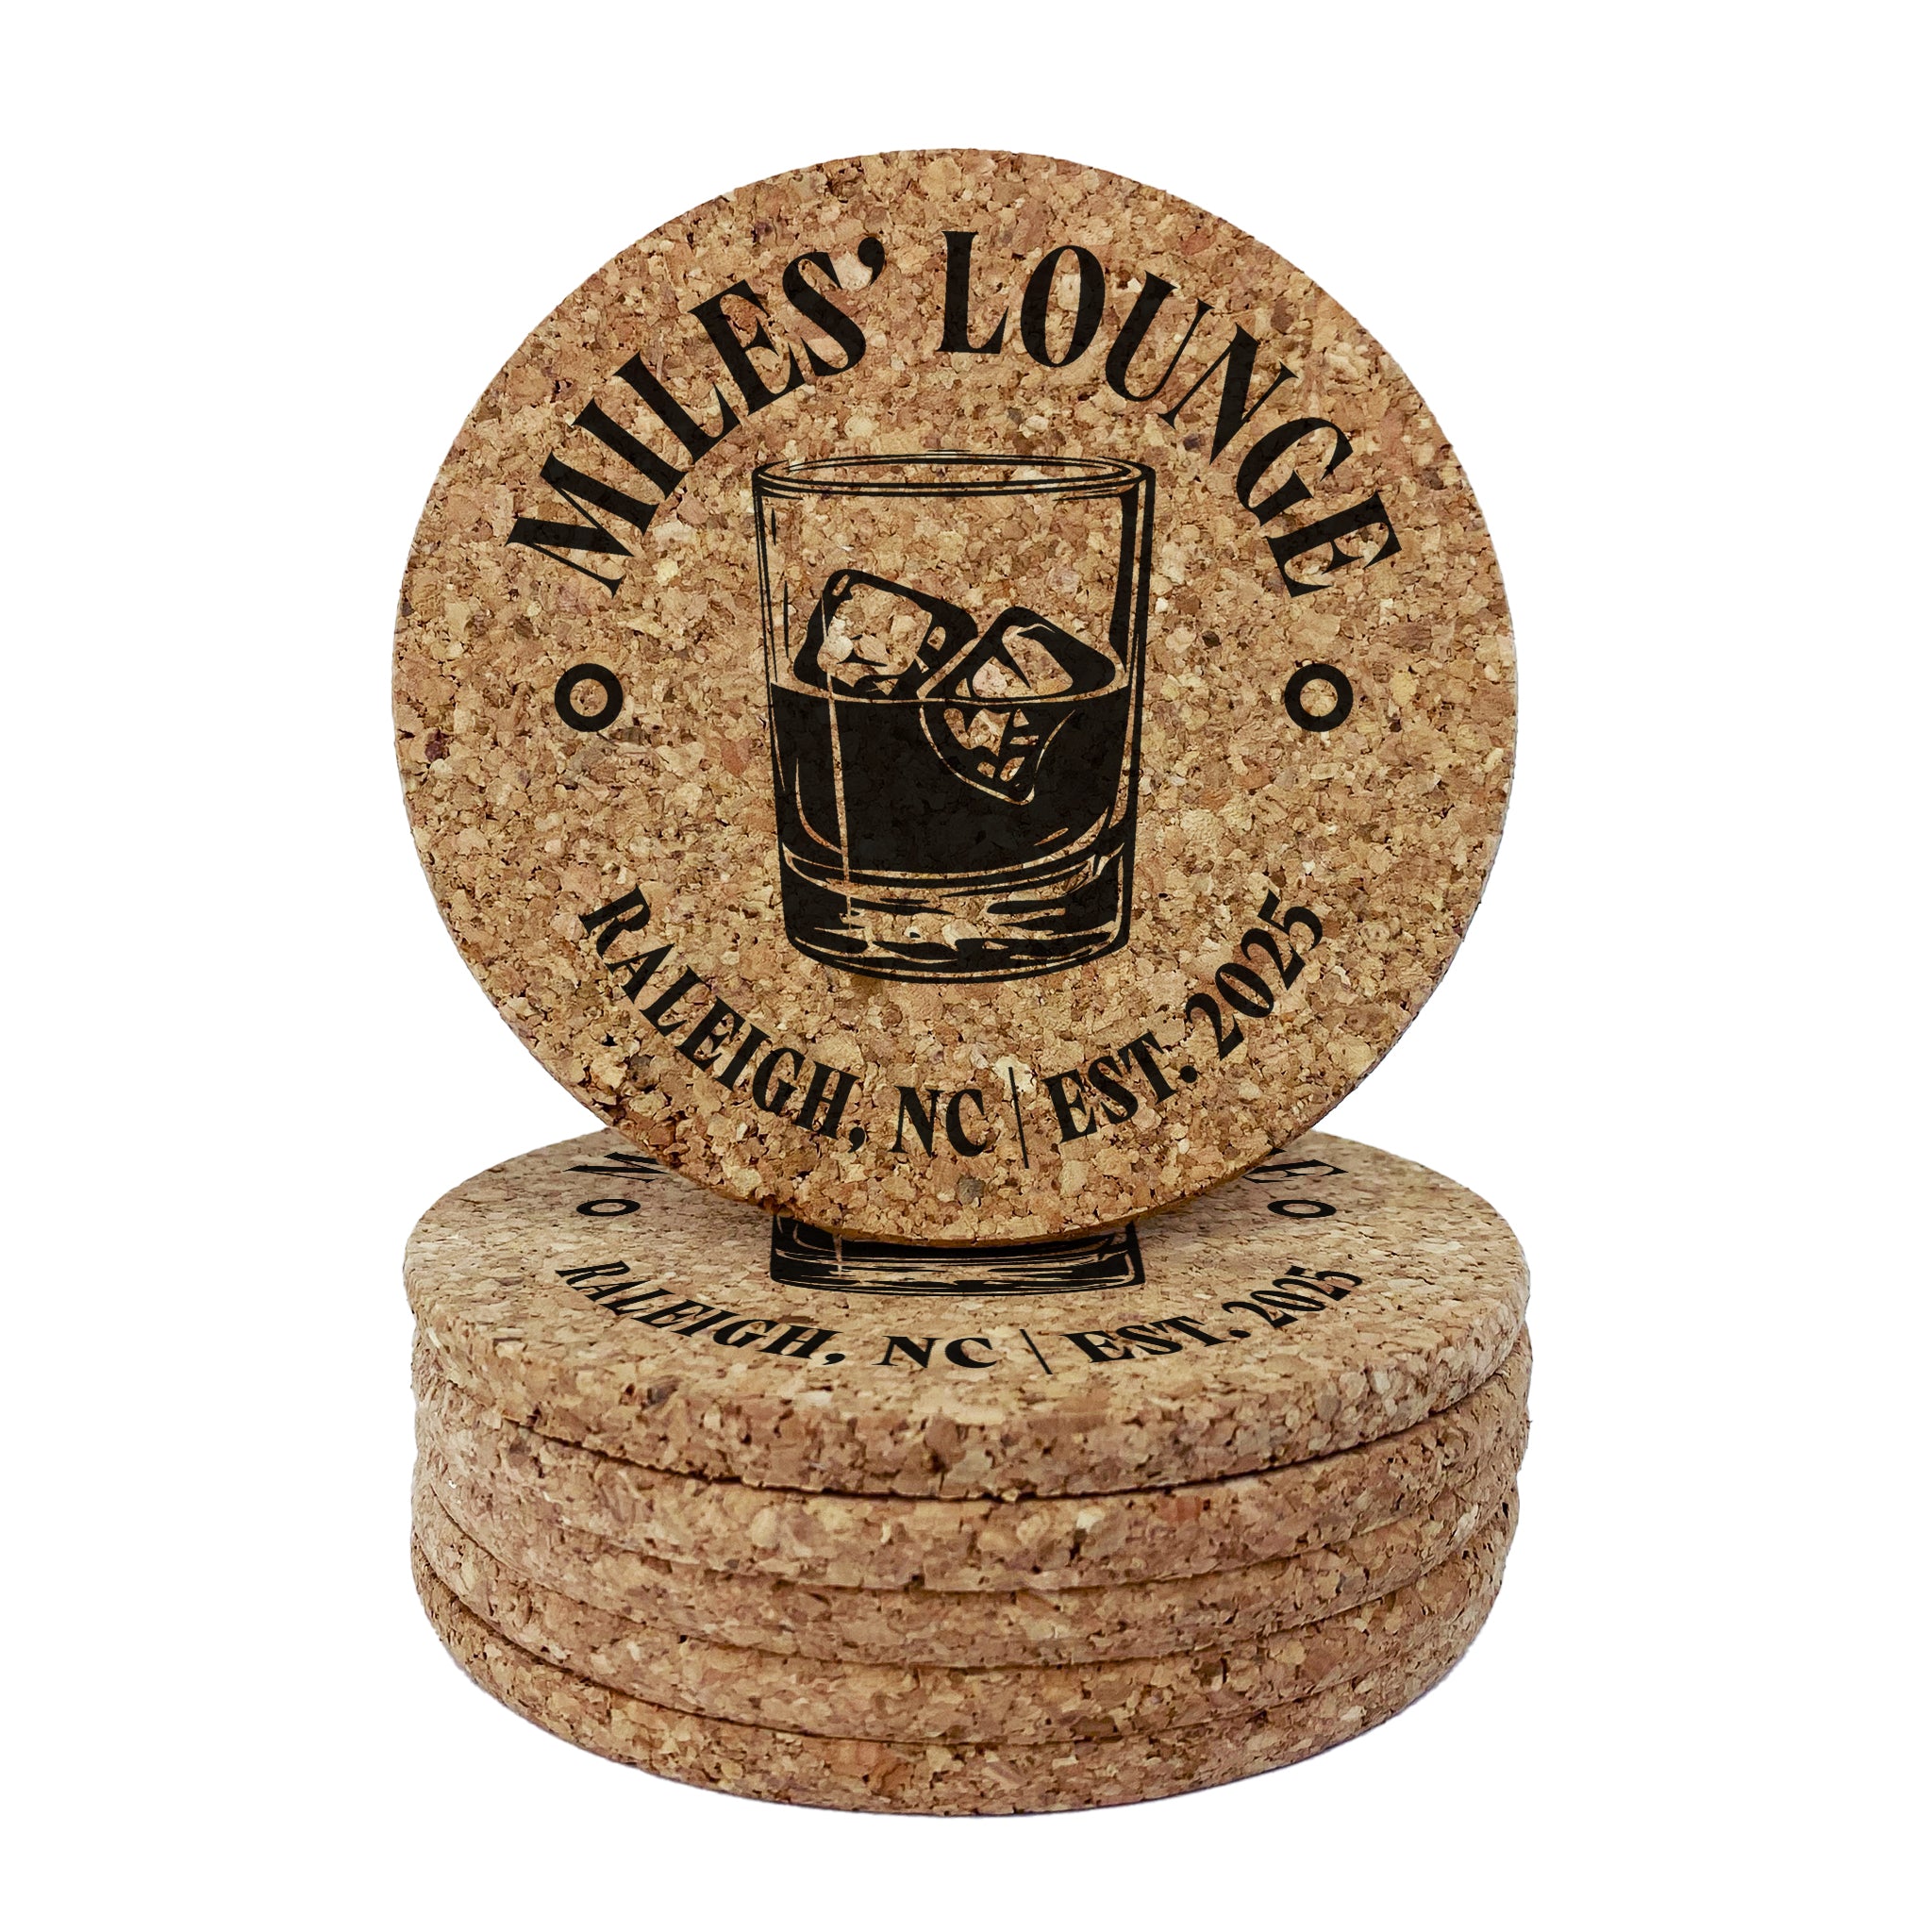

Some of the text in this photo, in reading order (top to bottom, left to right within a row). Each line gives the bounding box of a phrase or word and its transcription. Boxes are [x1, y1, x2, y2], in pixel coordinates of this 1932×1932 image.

[935, 230, 1403, 598] LOUNGE
[578, 883, 866, 1153] RALEIGH,
[888, 1086, 1000, 1160] NC
[1041, 1029, 1203, 1144] EST.
[1183, 889, 1324, 1061] 2025
[555, 1259, 847, 1366] RALEIGH,
[875, 1335, 997, 1369] NC
[1059, 1315, 1252, 1363] EST.
[1221, 1264, 1364, 1331] 2025
